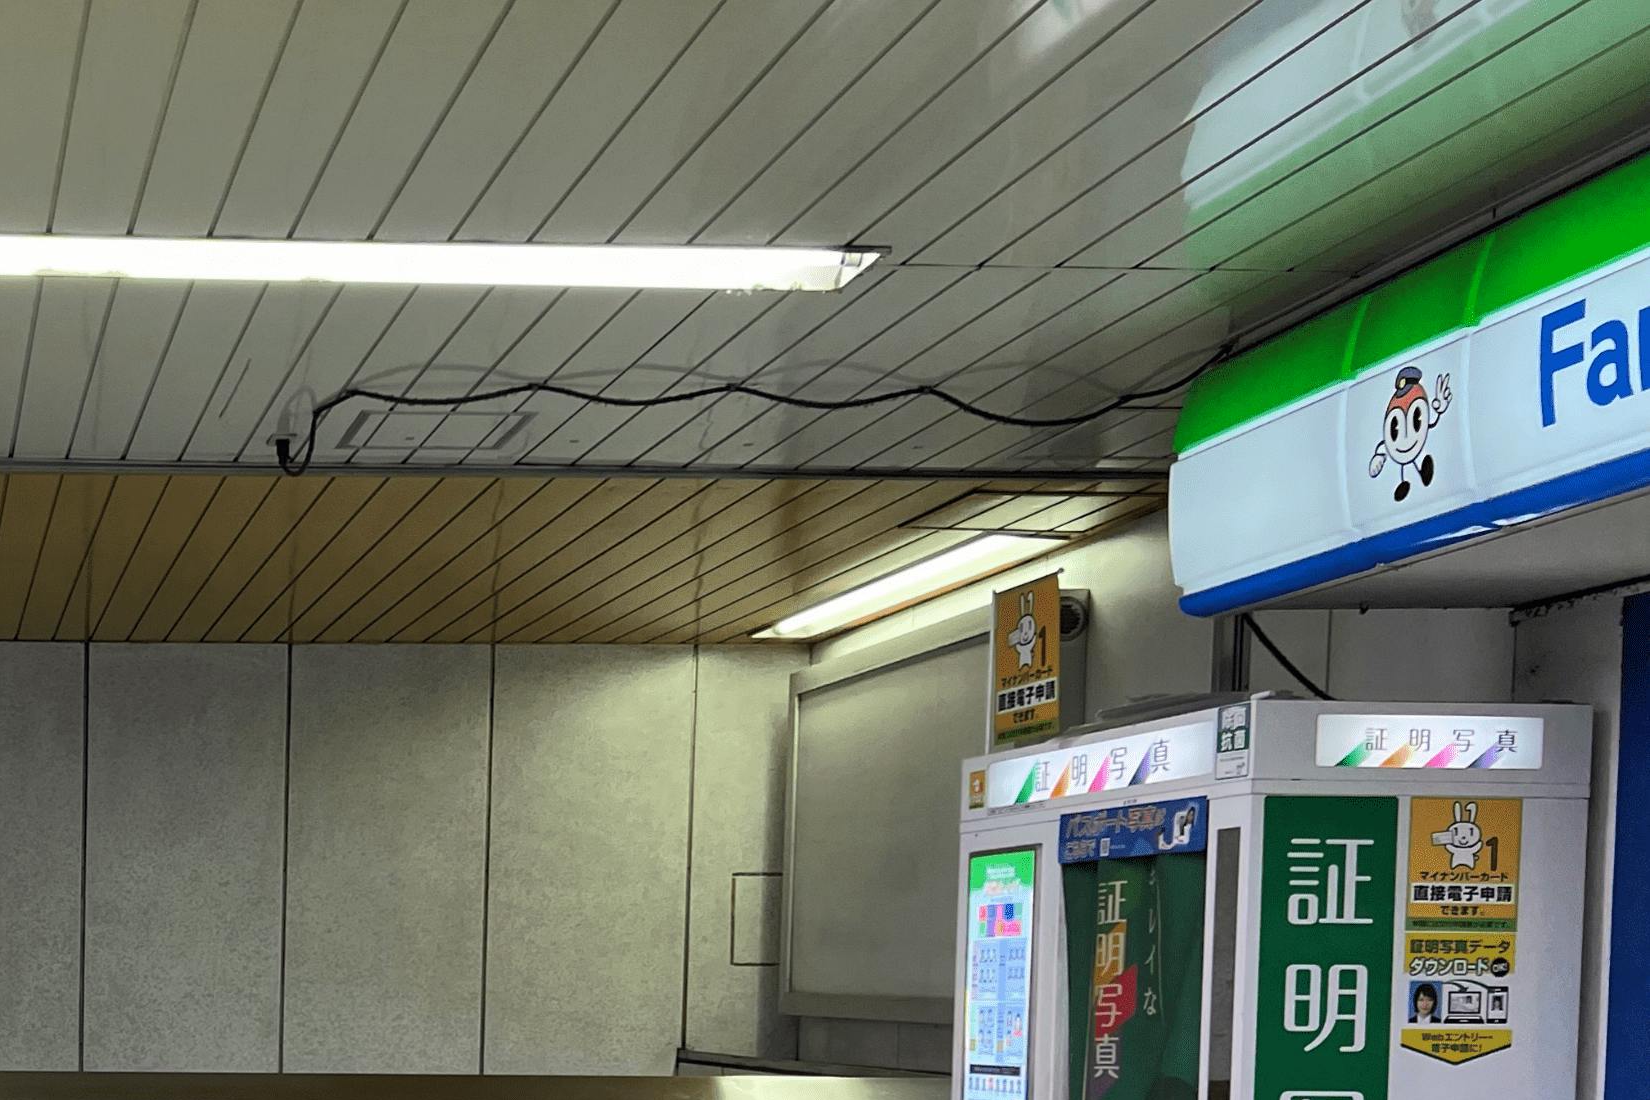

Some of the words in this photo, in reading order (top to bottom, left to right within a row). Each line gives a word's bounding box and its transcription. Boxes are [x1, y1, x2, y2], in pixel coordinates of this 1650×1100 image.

[1540, 298, 1650, 427] Fa
[1365, 728, 1519, 753] 証明写真
[1034, 738, 1173, 793] 証明写真
[1419, 871, 1508, 882] マイナンバーカード
[1413, 885, 1513, 902] 直接電子申請
[1410, 939, 1511, 953] 証明写真データ
[1409, 957, 1489, 976] ダウンロード
[1093, 880, 1129, 1080] 証明写真
